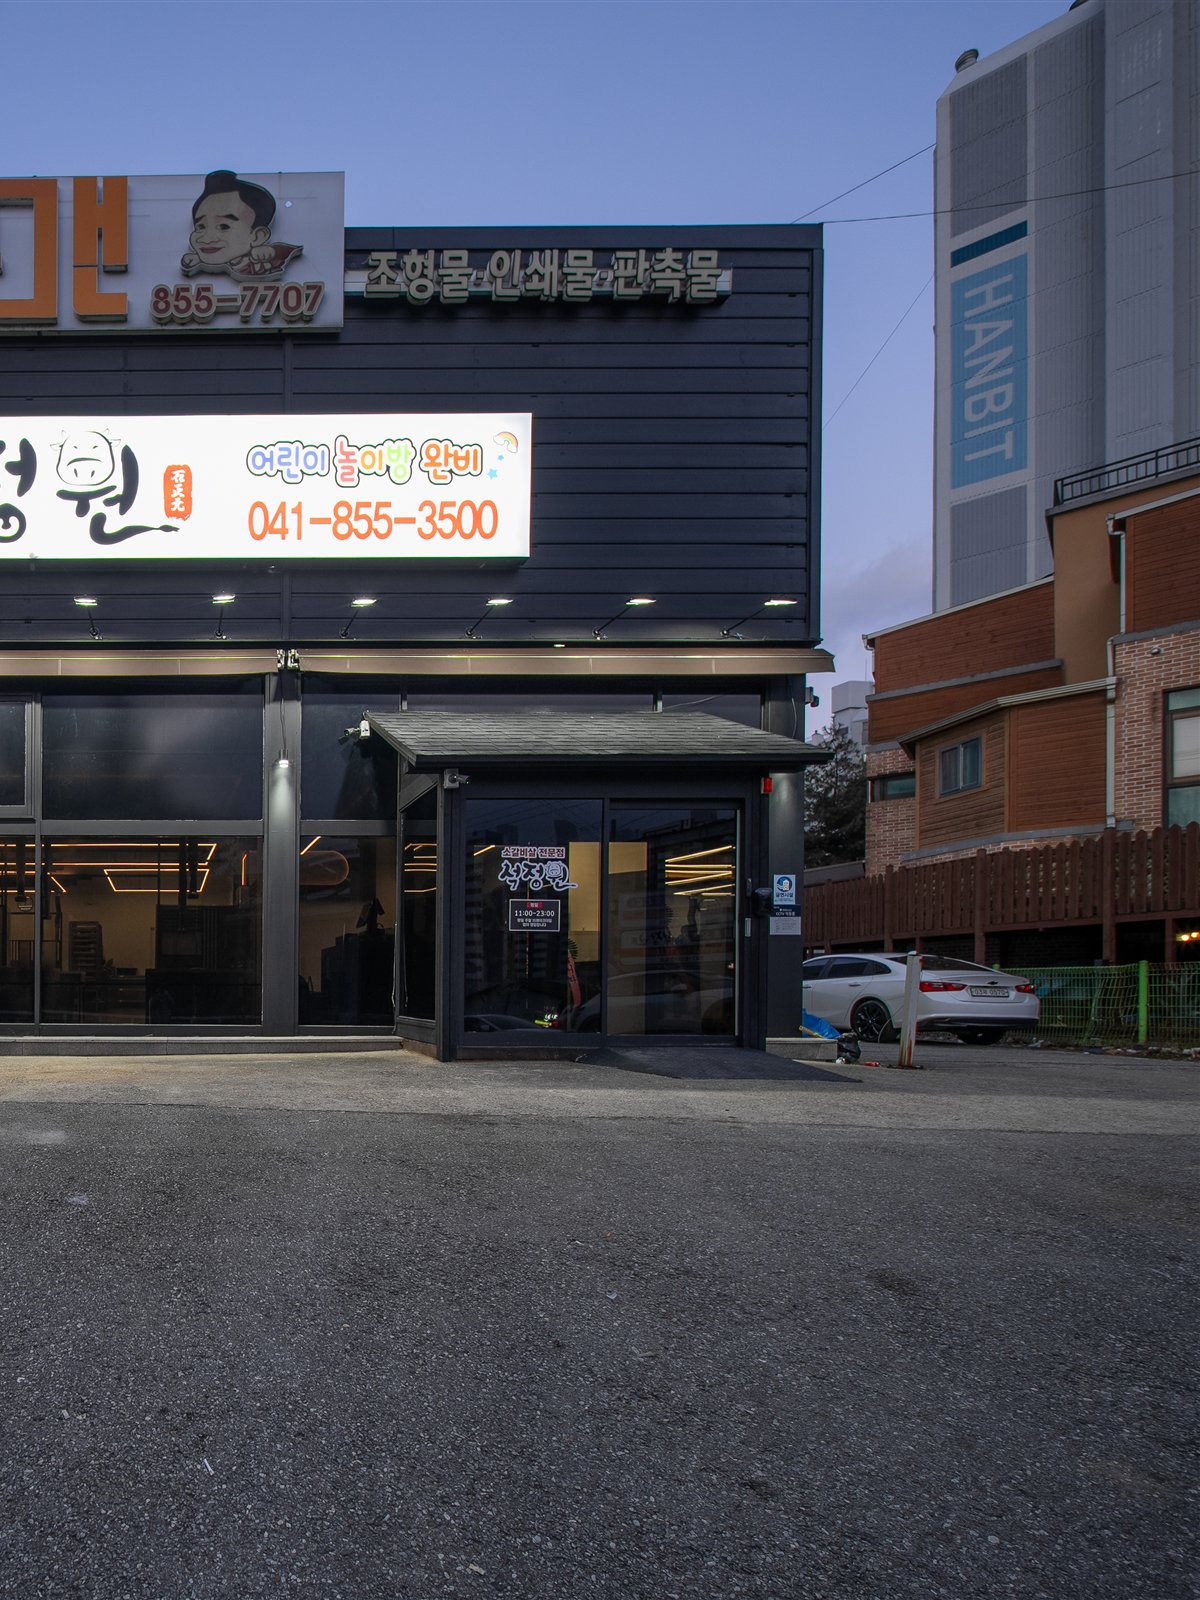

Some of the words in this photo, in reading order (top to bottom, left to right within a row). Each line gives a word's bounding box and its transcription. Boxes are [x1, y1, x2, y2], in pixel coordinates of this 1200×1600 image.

[150, 281, 325, 321] 855-7707
[964, 273, 1014, 462] HANBIT
[246, 440, 330, 485] 어린이
[332, 434, 417, 488] 놀이방
[419, 438, 484, 486] 완비
[247, 499, 499, 541] 041-855-3500
[501, 846, 537, 859] 소갈비살
[538, 847, 566, 859] 전문점
